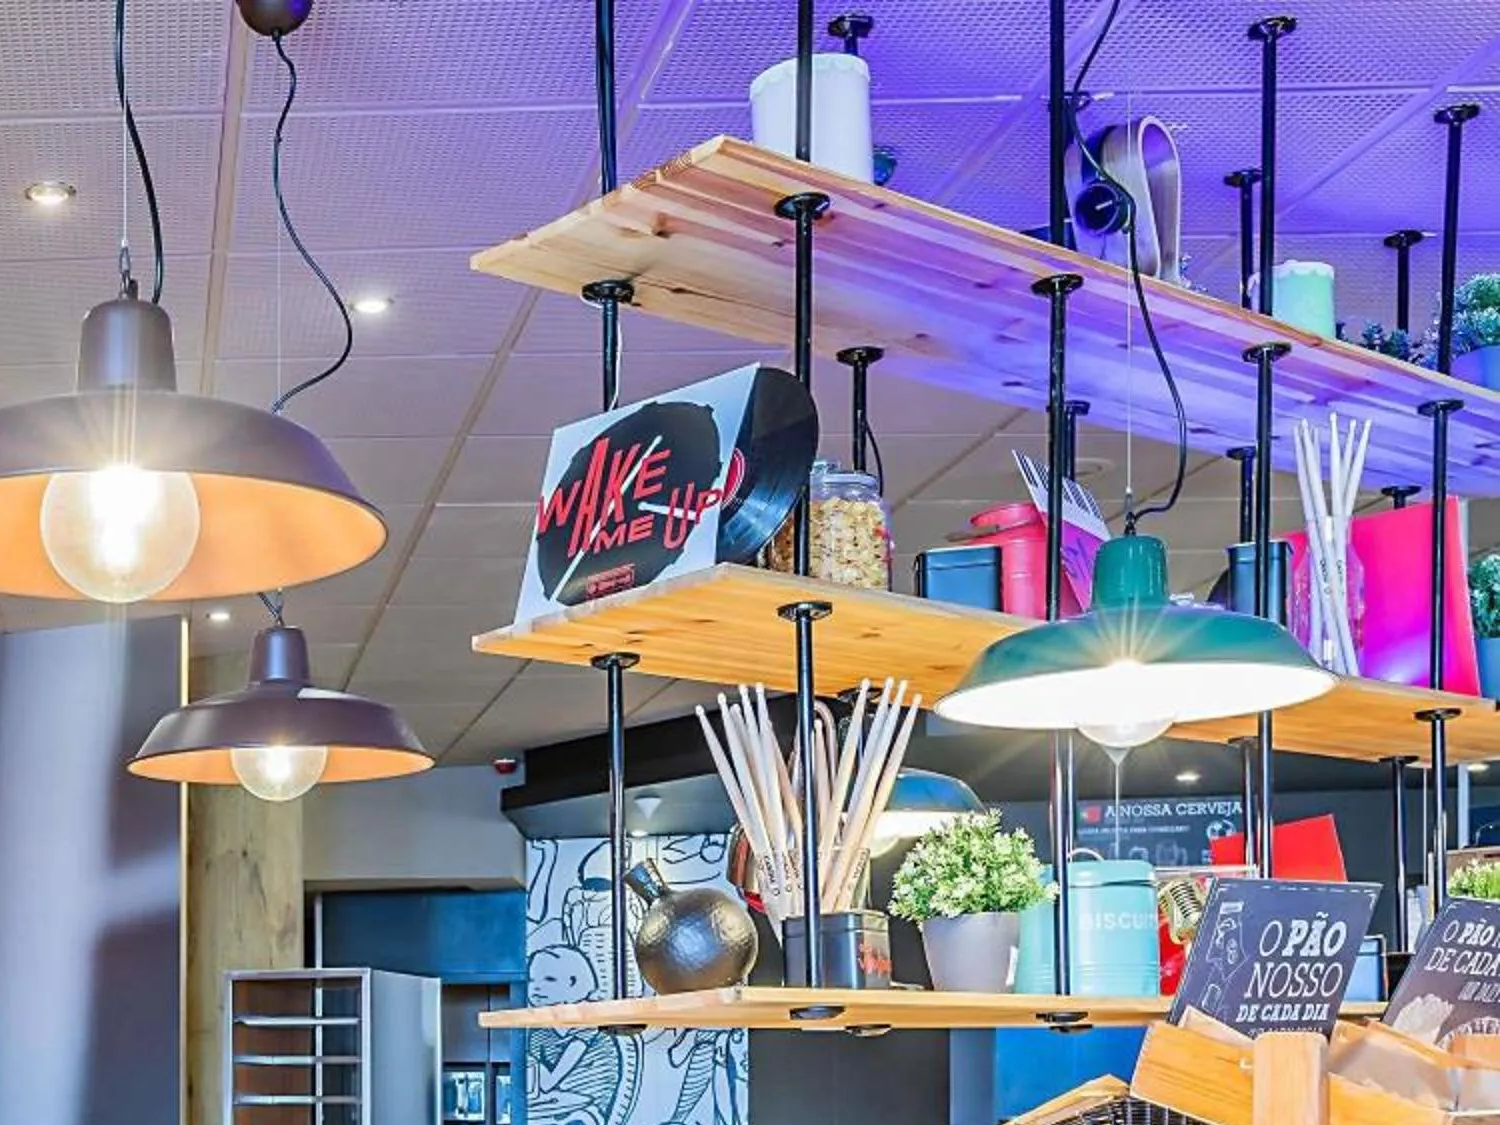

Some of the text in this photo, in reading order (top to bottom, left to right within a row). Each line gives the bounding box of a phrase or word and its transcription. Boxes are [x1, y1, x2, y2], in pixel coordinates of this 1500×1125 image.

[537, 436, 672, 558] WAKE
[594, 481, 724, 554] ME UP
[1105, 801, 1243, 818] A NOSSA CERVEJA
[1259, 911, 1348, 957] O PÃO
[1442, 920, 1461, 943] O
[1457, 917, 1495, 947] PÃO
[1423, 946, 1458, 973] DE
[1243, 961, 1344, 999] NOSSO
[1235, 1003, 1331, 1023] DE CADA DIA
